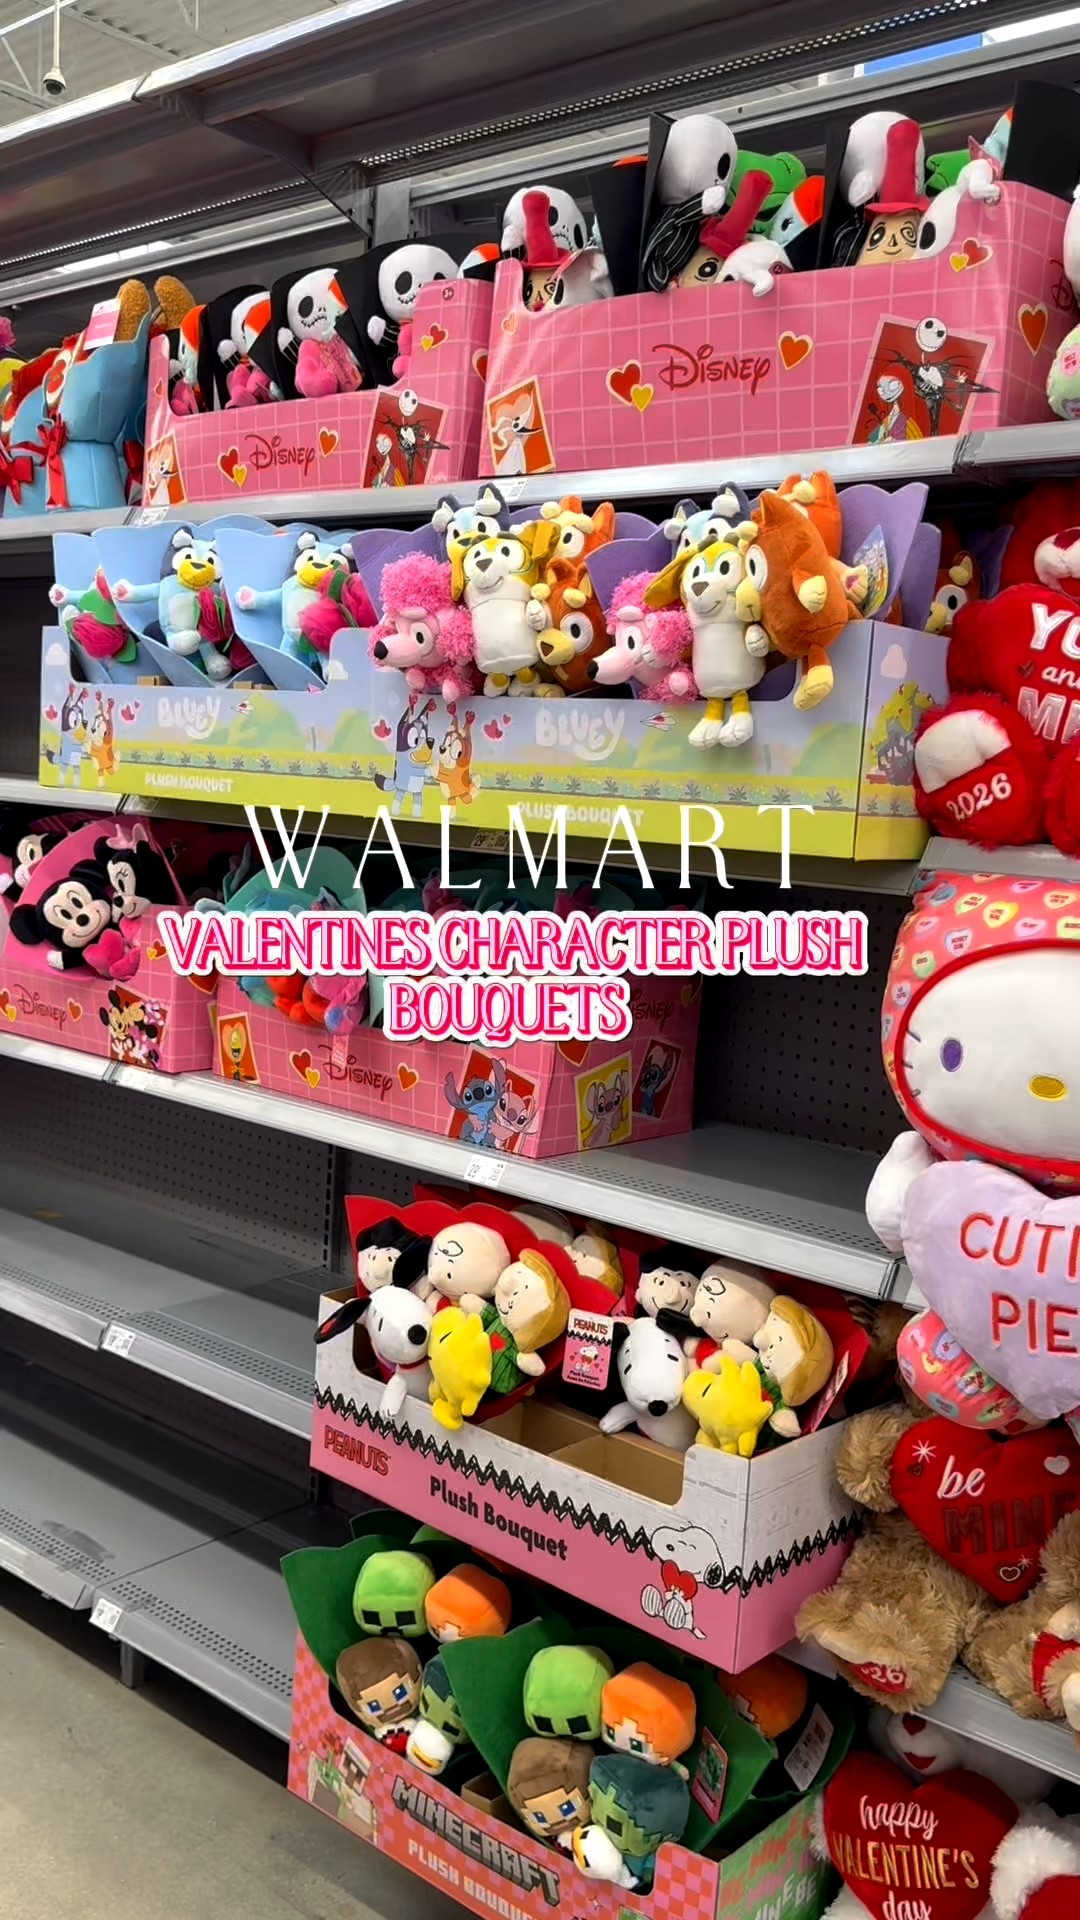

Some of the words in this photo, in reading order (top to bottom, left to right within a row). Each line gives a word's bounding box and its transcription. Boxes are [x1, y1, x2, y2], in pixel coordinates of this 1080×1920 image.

[652, 344, 770, 396] Disney
[245, 434, 315, 476] Disney
[946, 772, 1012, 821] 2026
[13, 983, 67, 1031] Disney
[573, 1317, 609, 1336] PEANUTS
[323, 1424, 389, 1476] PEANUTS
[937, 1454, 985, 1499] be
[430, 1475, 479, 1519] Plush
[483, 1501, 569, 1561] Bouquet
[391, 1775, 560, 1907] MINECRAFT
[859, 1794, 939, 1841] happy
[407, 1838, 460, 1888] PLUSH
[832, 1831, 980, 1889] VALENTINE'S
